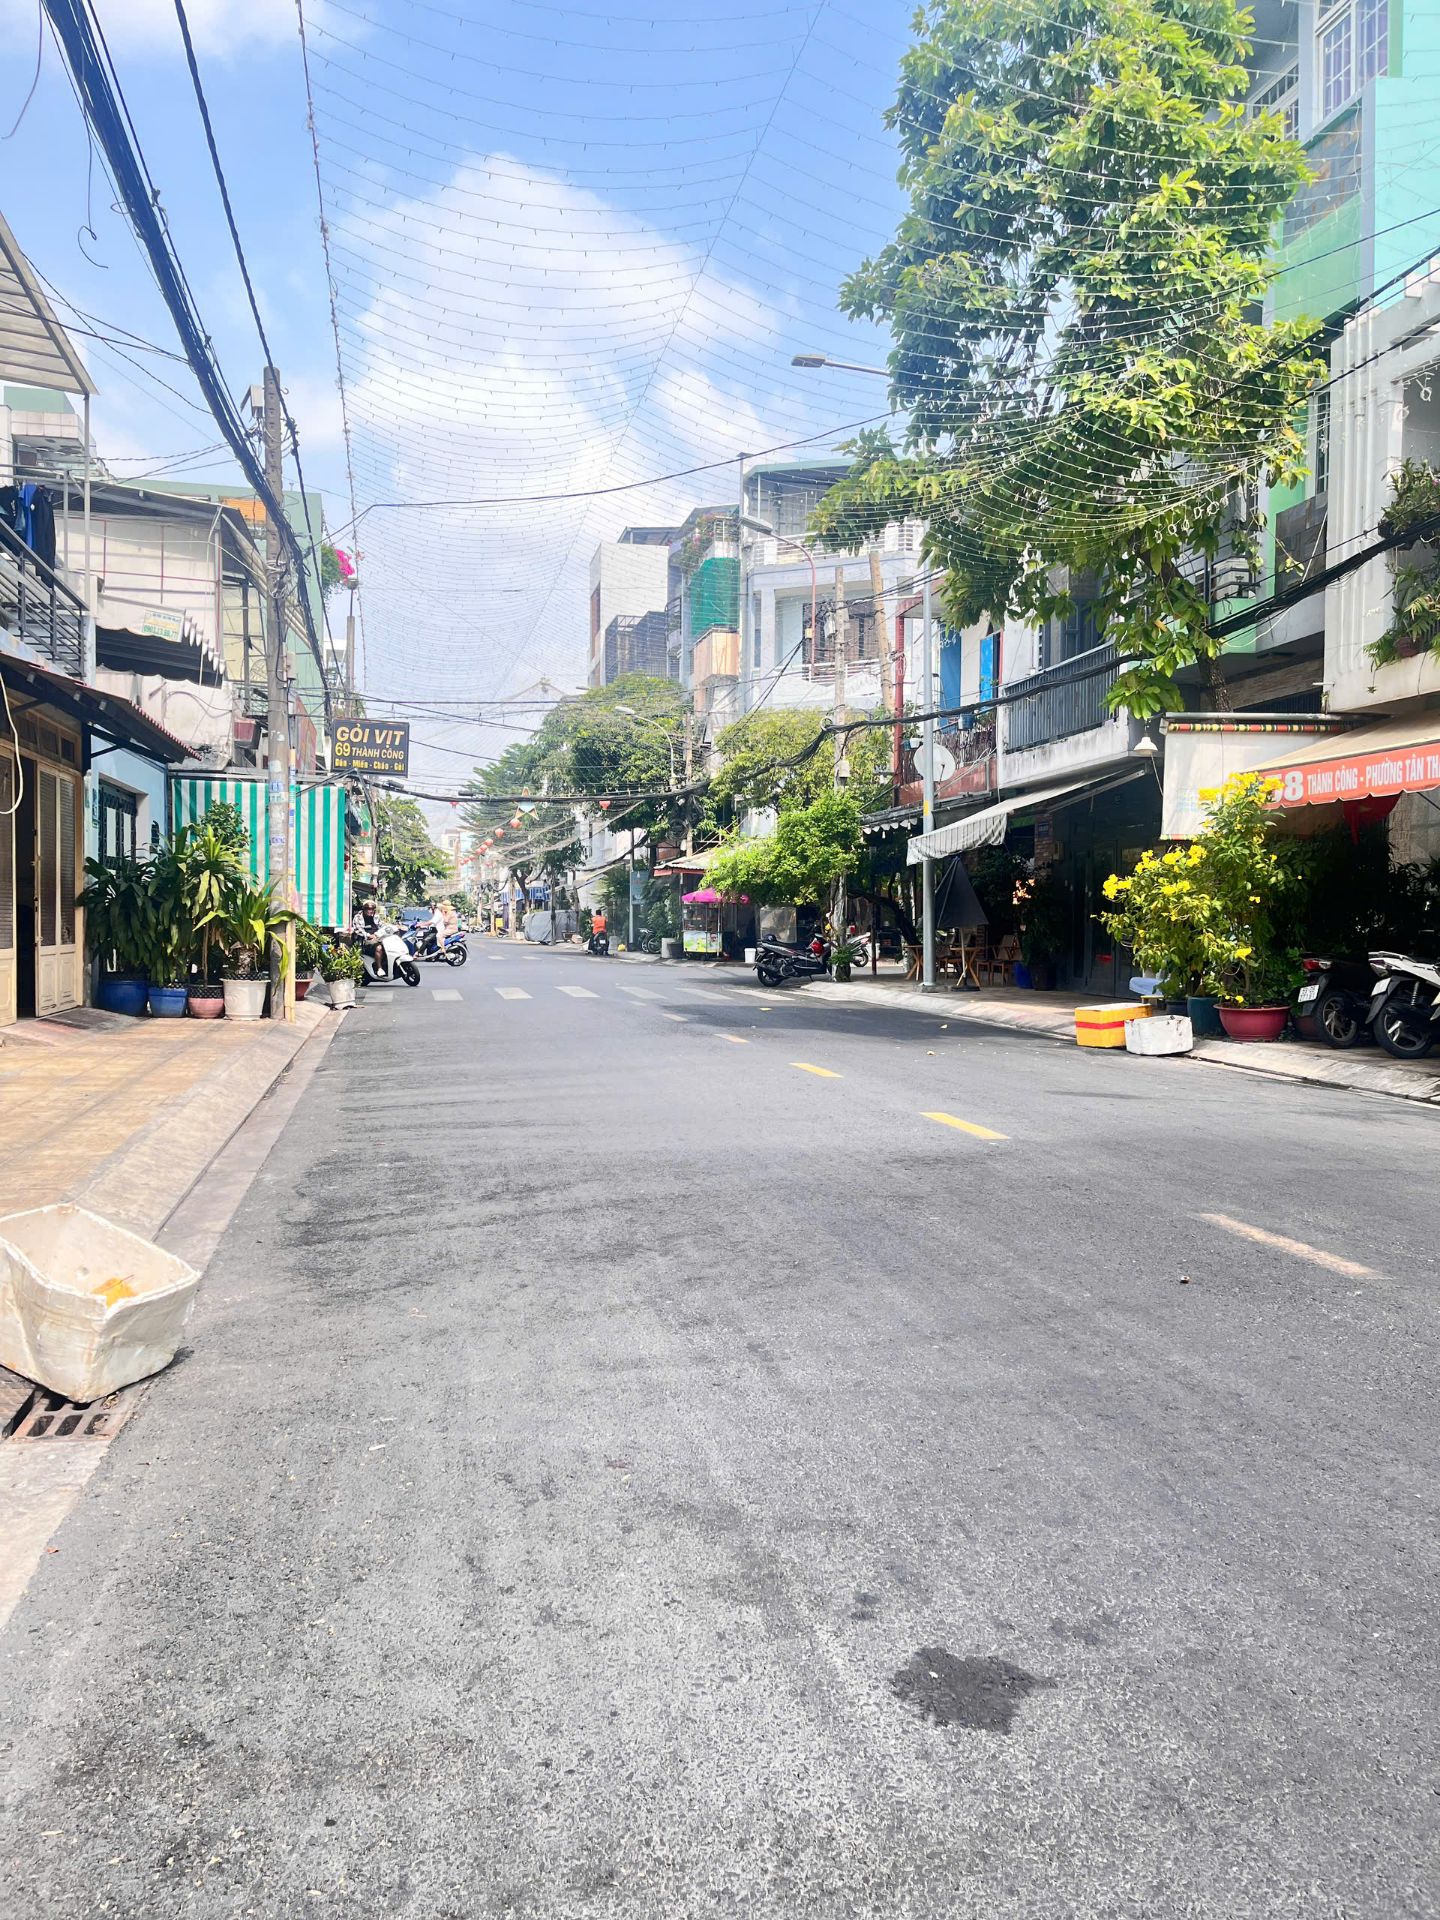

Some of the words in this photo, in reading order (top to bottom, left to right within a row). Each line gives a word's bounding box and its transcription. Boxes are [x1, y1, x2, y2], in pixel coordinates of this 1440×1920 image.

[336, 723, 370, 743] GỎI
[374, 729, 405, 748] VỊT
[335, 742, 351, 757] 69
[352, 746, 380, 758] THÀNH
[381, 748, 404, 760] CÔNG
[1307, 769, 1334, 796] THÀNH
[1335, 765, 1358, 792] CÔNG
[1365, 758, 1403, 788] PHƯỜNG
[1405, 754, 1424, 782] TÂN
[1426, 755, 1440, 779] TH
